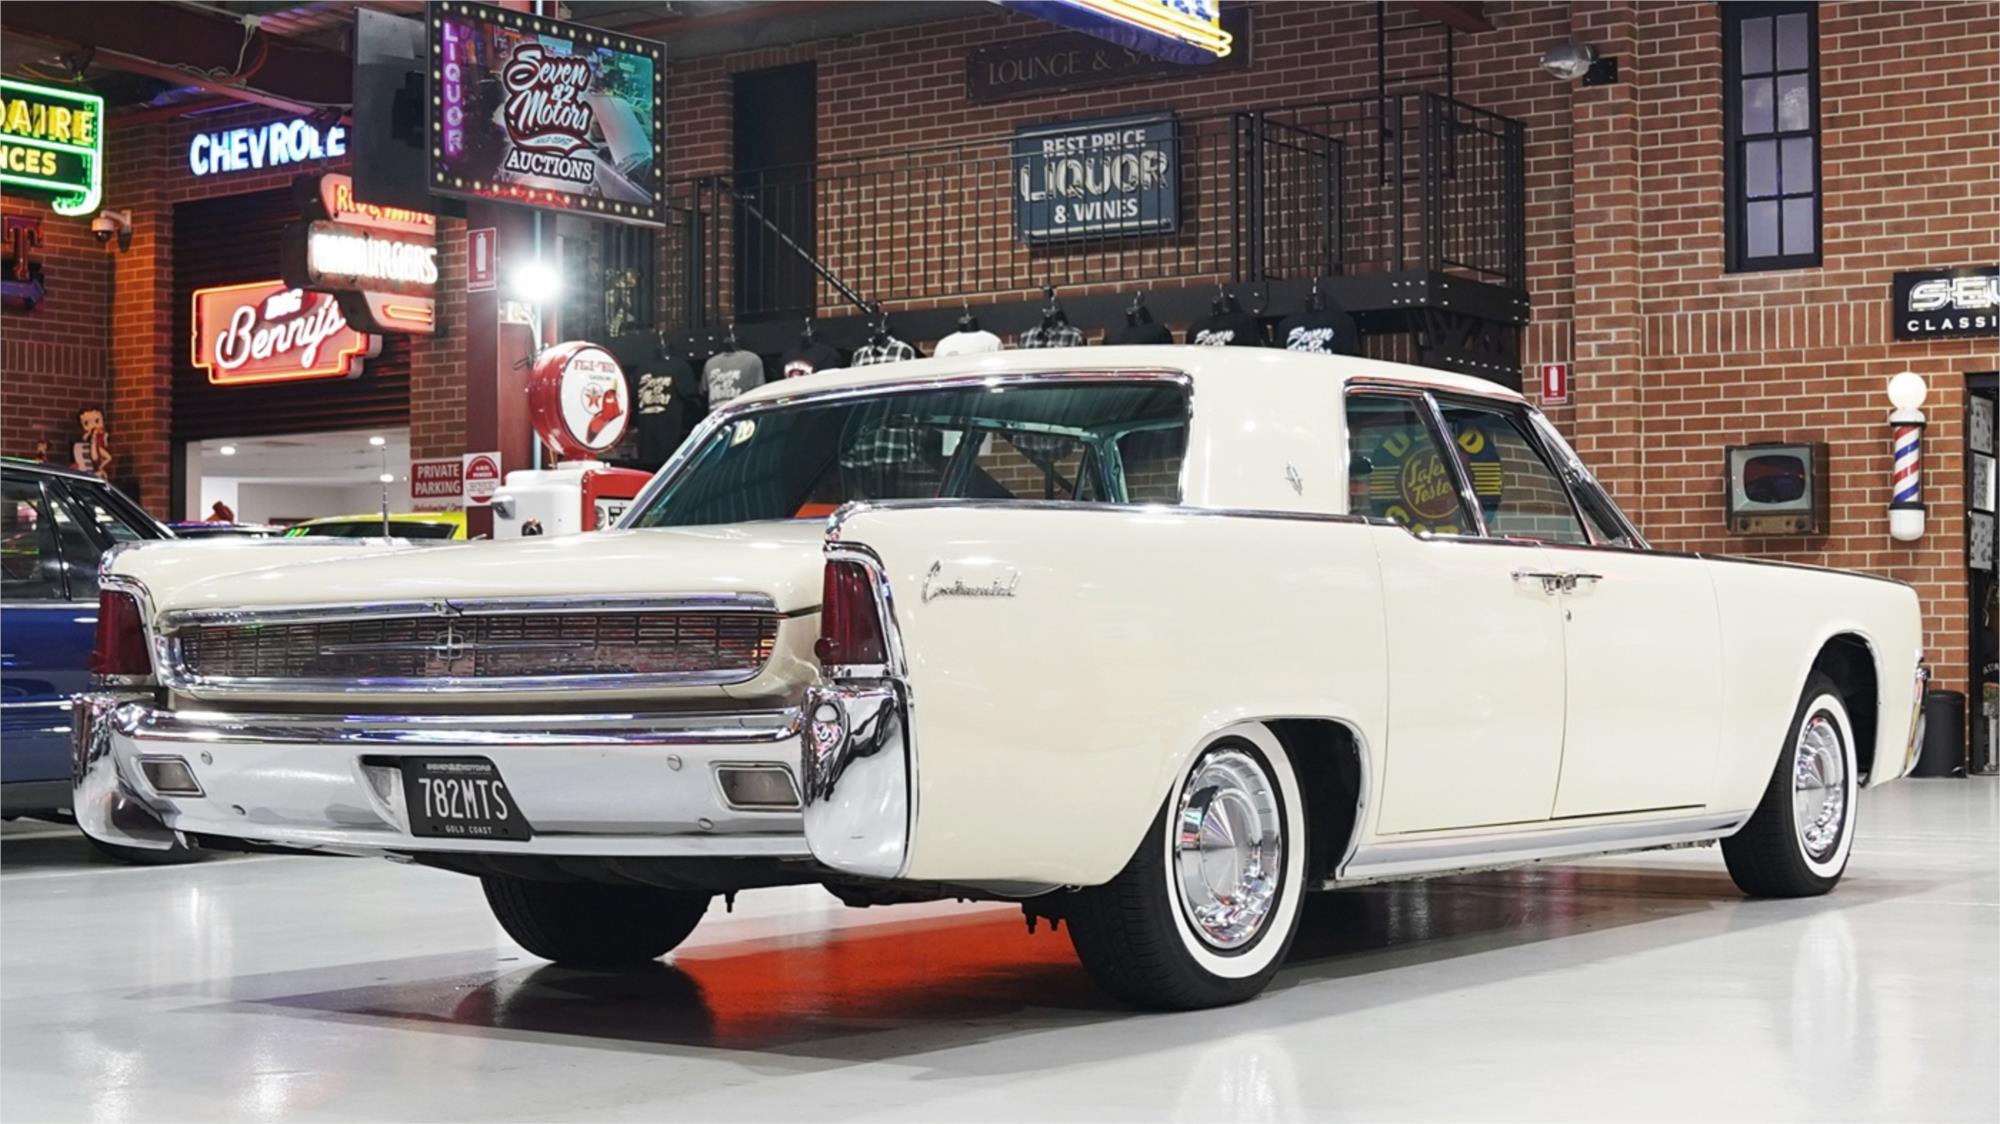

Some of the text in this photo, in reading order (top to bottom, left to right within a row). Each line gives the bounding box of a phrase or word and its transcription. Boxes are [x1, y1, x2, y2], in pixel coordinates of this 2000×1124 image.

[507, 49, 588, 91] Seven
[988, 50, 1082, 86] LOUNGE
[1091, 49, 1113, 72] &
[443, 22, 464, 153] LIQUOR
[551, 84, 575, 103] 82
[508, 90, 590, 134] Motors
[1042, 129, 1147, 158] BEST PRICE
[506, 151, 593, 181] AUCTIONS
[1020, 149, 1169, 202] LIQUOR
[1054, 197, 1138, 224] & WINES
[215, 294, 347, 369] Benny's
[1907, 316, 1997, 332] CLASSI
[417, 464, 460, 479] PRIVATE
[415, 480, 461, 496] PARKING
[418, 778, 508, 820] 782MTS
[445, 825, 492, 835] GOLD COAST
